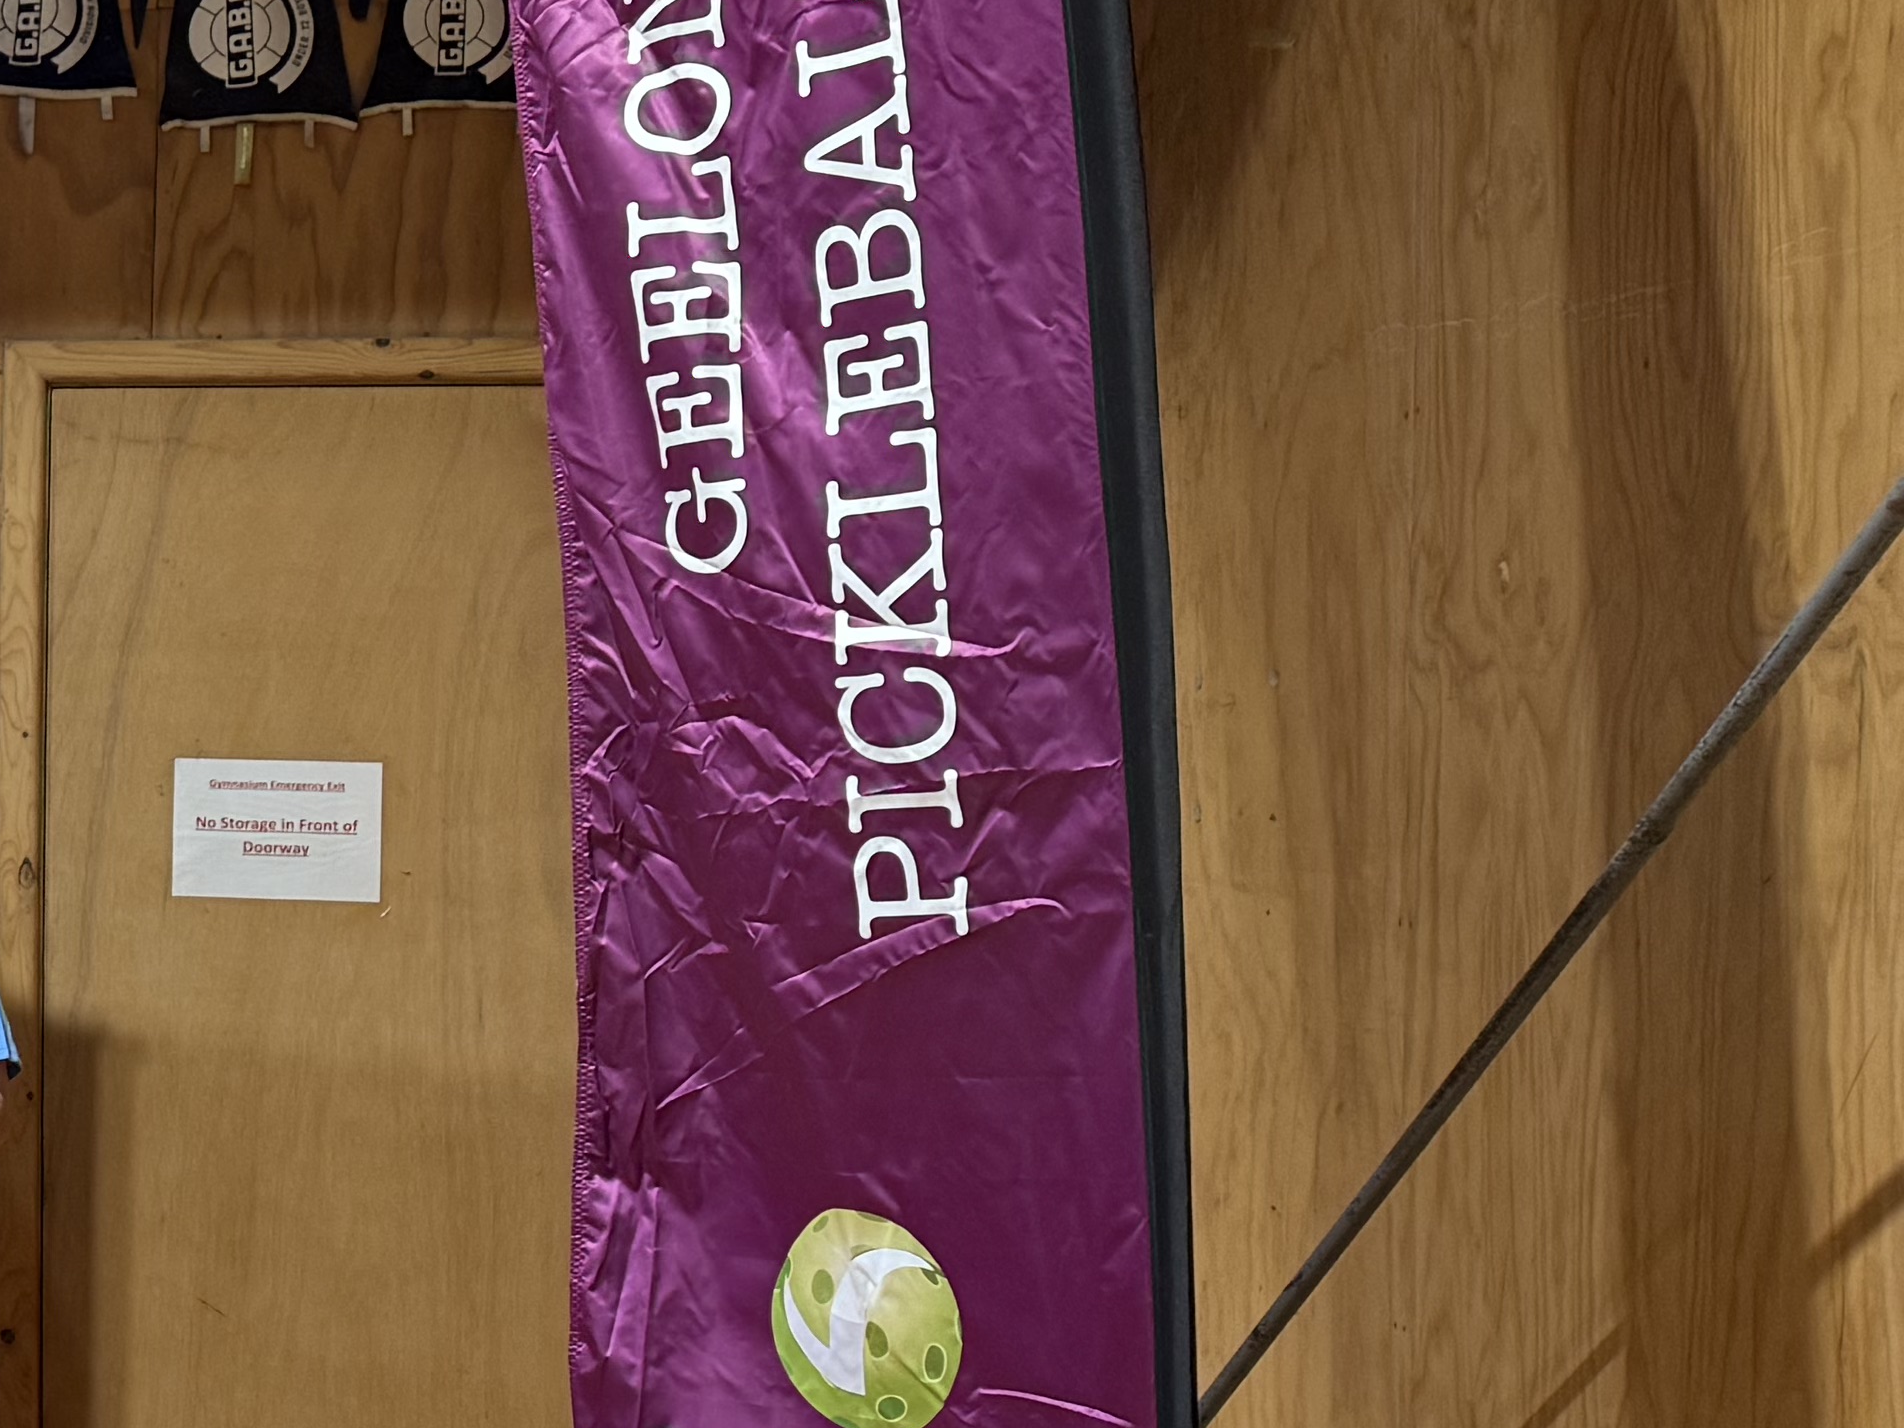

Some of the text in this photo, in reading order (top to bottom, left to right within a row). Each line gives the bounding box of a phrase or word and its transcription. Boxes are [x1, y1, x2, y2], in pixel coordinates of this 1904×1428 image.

[327, 782, 345, 792] Exit
[196, 817, 359, 832] No Storage in Front of
[243, 841, 309, 856] Doorway
